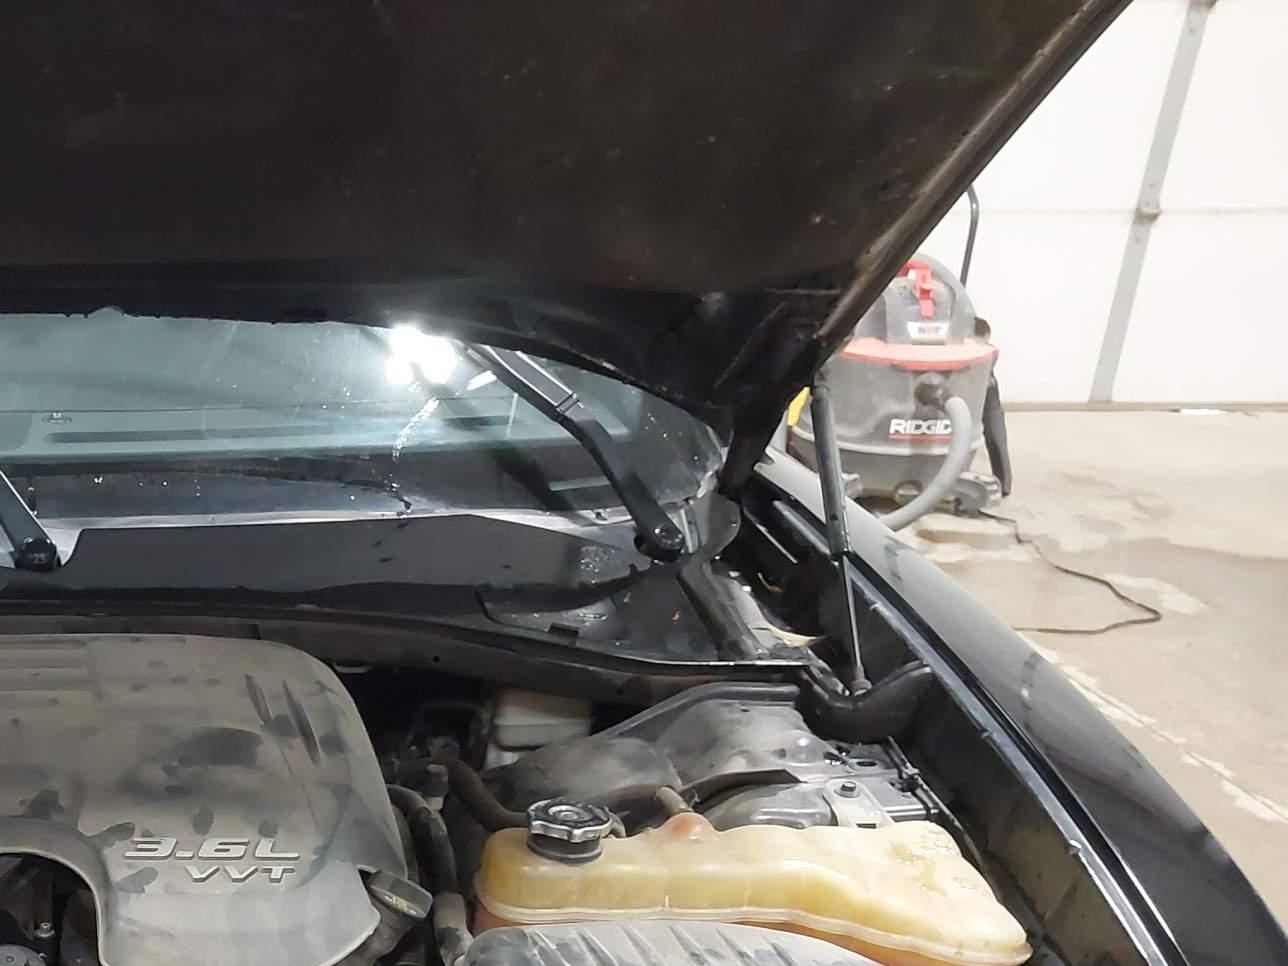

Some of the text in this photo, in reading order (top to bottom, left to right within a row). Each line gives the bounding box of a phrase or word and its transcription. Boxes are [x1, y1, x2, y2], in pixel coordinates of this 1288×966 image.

[889, 418, 952, 435] RIDGID
[123, 837, 300, 860] 3.6L
[185, 865, 295, 883] VVT
